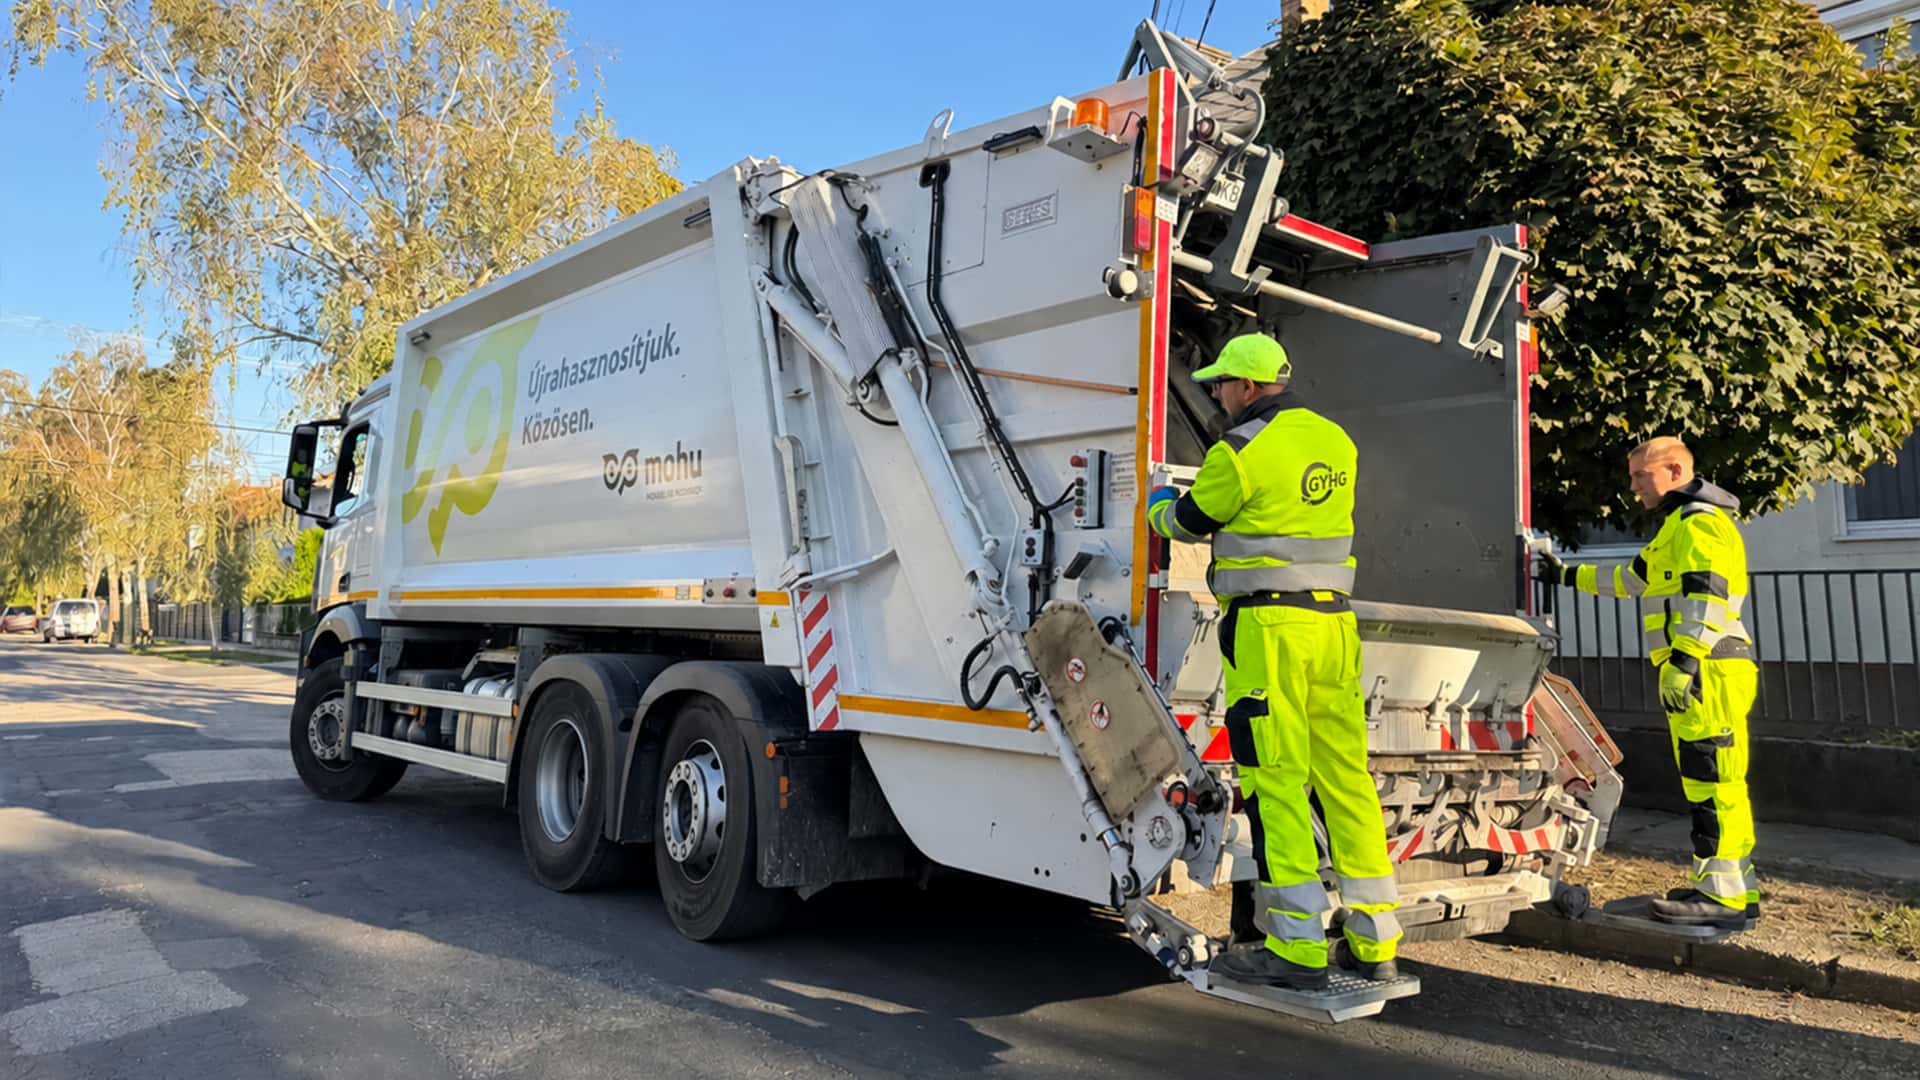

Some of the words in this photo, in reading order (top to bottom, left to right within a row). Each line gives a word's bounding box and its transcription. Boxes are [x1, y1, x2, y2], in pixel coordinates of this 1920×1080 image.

[527, 322, 681, 404] Újrahasznosítjuk.
[521, 407, 595, 446] Közösen.
[644, 440, 703, 486] mohu
[1308, 471, 1348, 492] GYHG
